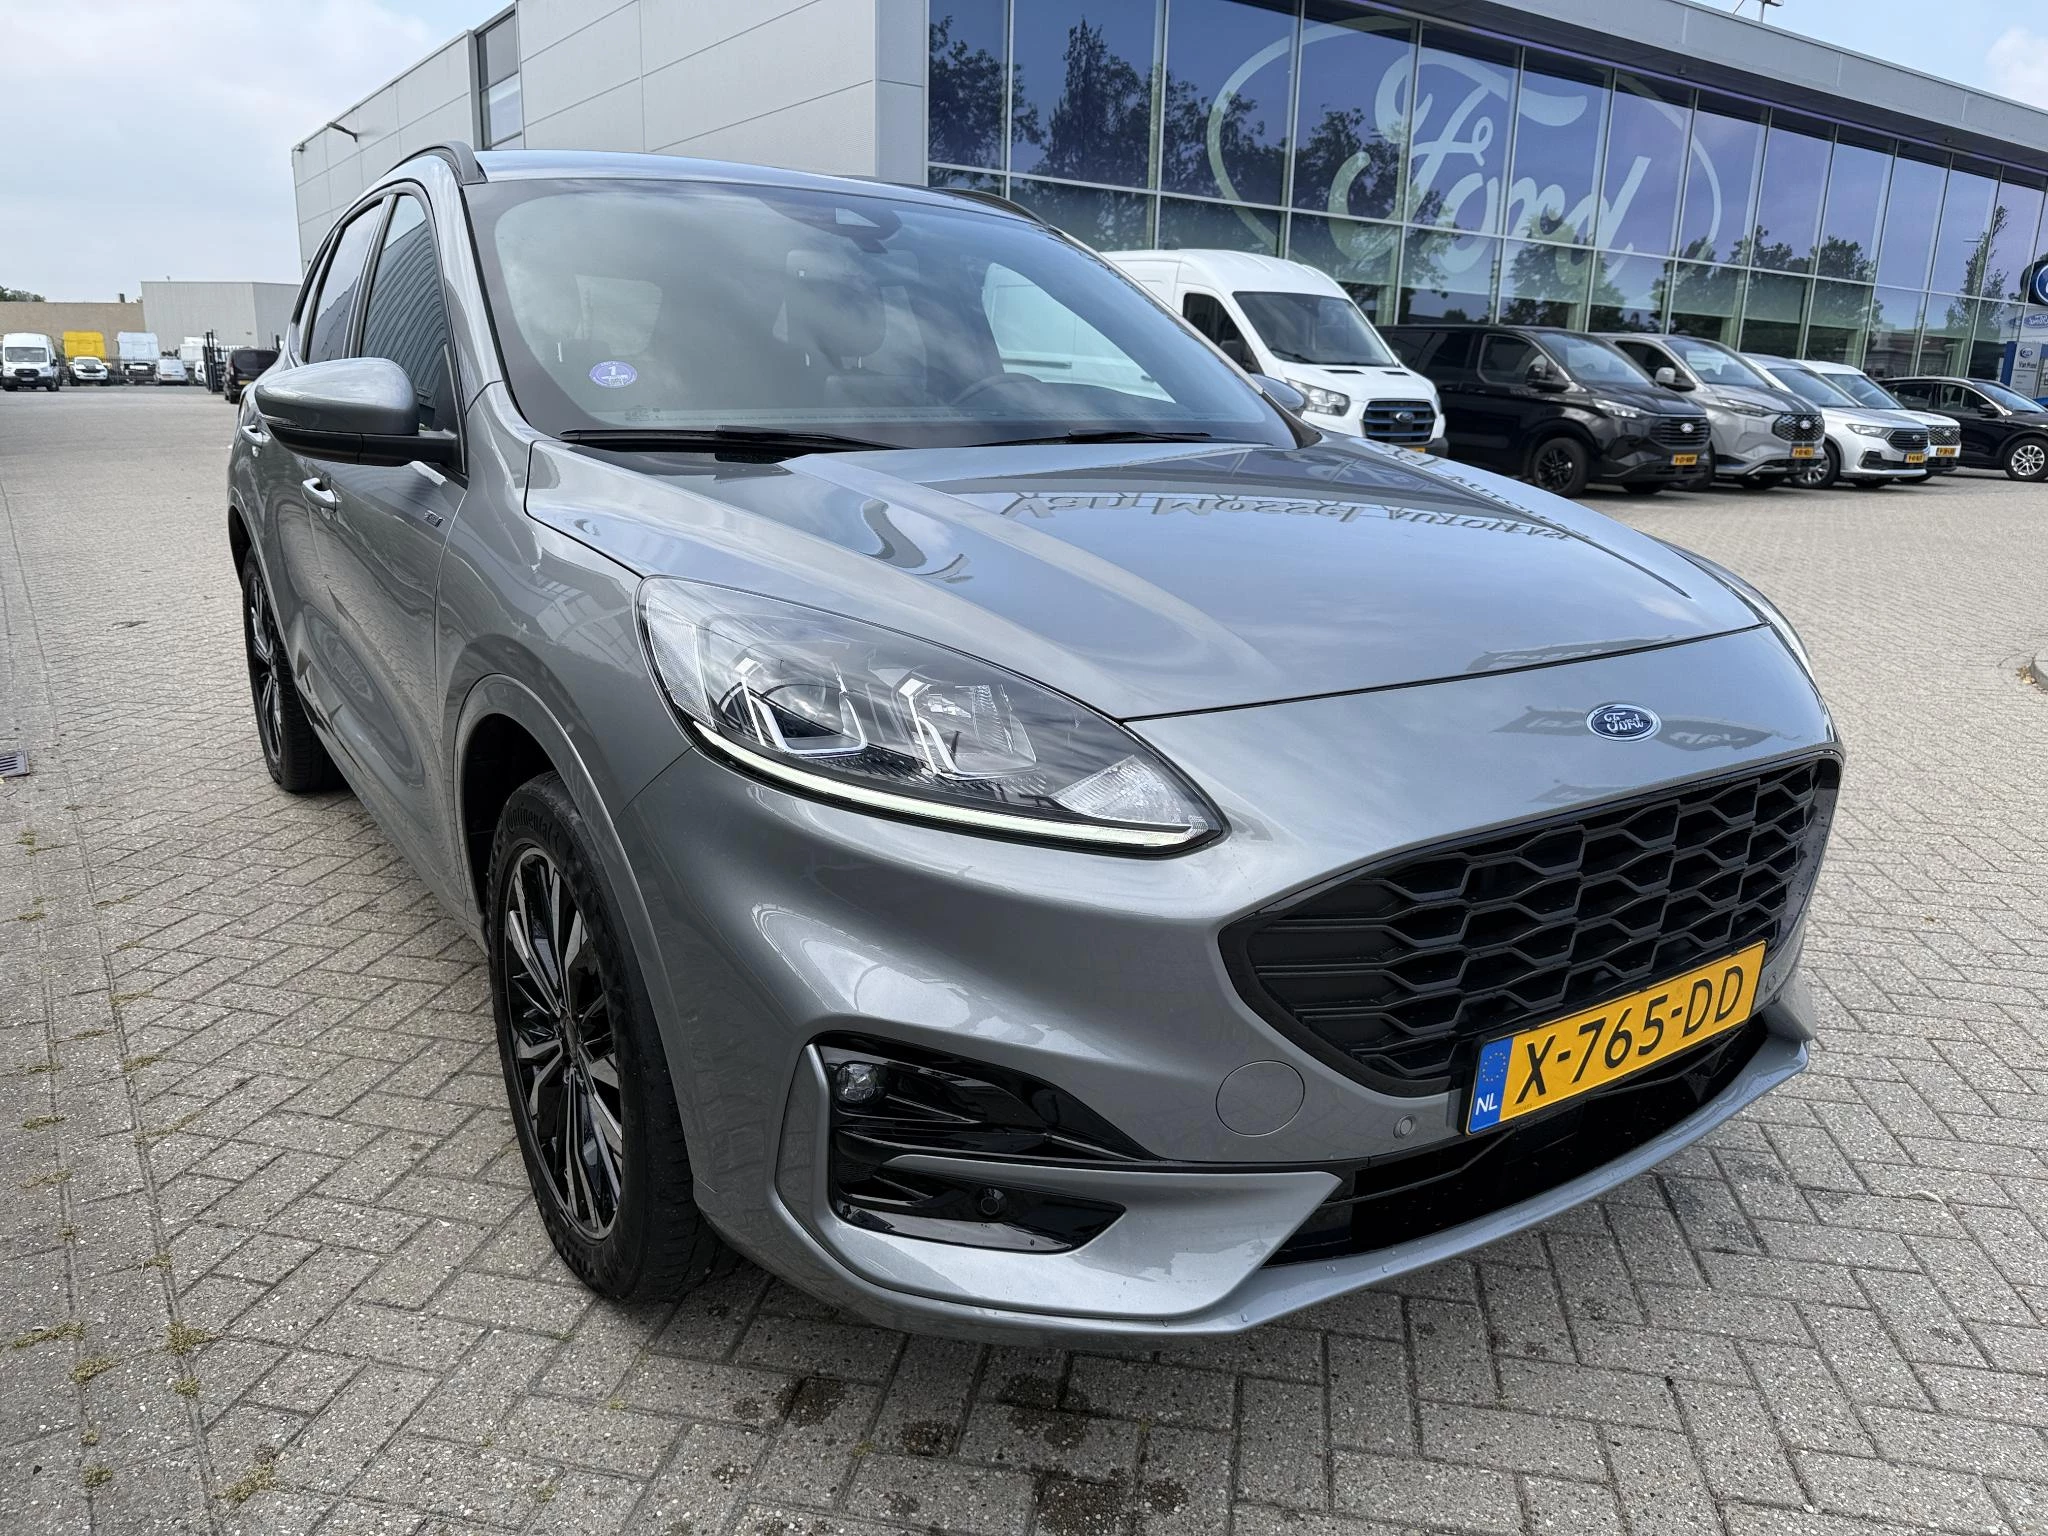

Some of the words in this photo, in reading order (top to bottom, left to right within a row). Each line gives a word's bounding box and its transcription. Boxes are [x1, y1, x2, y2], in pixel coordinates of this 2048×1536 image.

[1328, 50, 1652, 284] Ford
[608, 366, 616, 375] 1
[1604, 711, 1643, 733] Ford
[1515, 965, 1744, 1105] X-765-DD
[1475, 1093, 1498, 1116] NL
